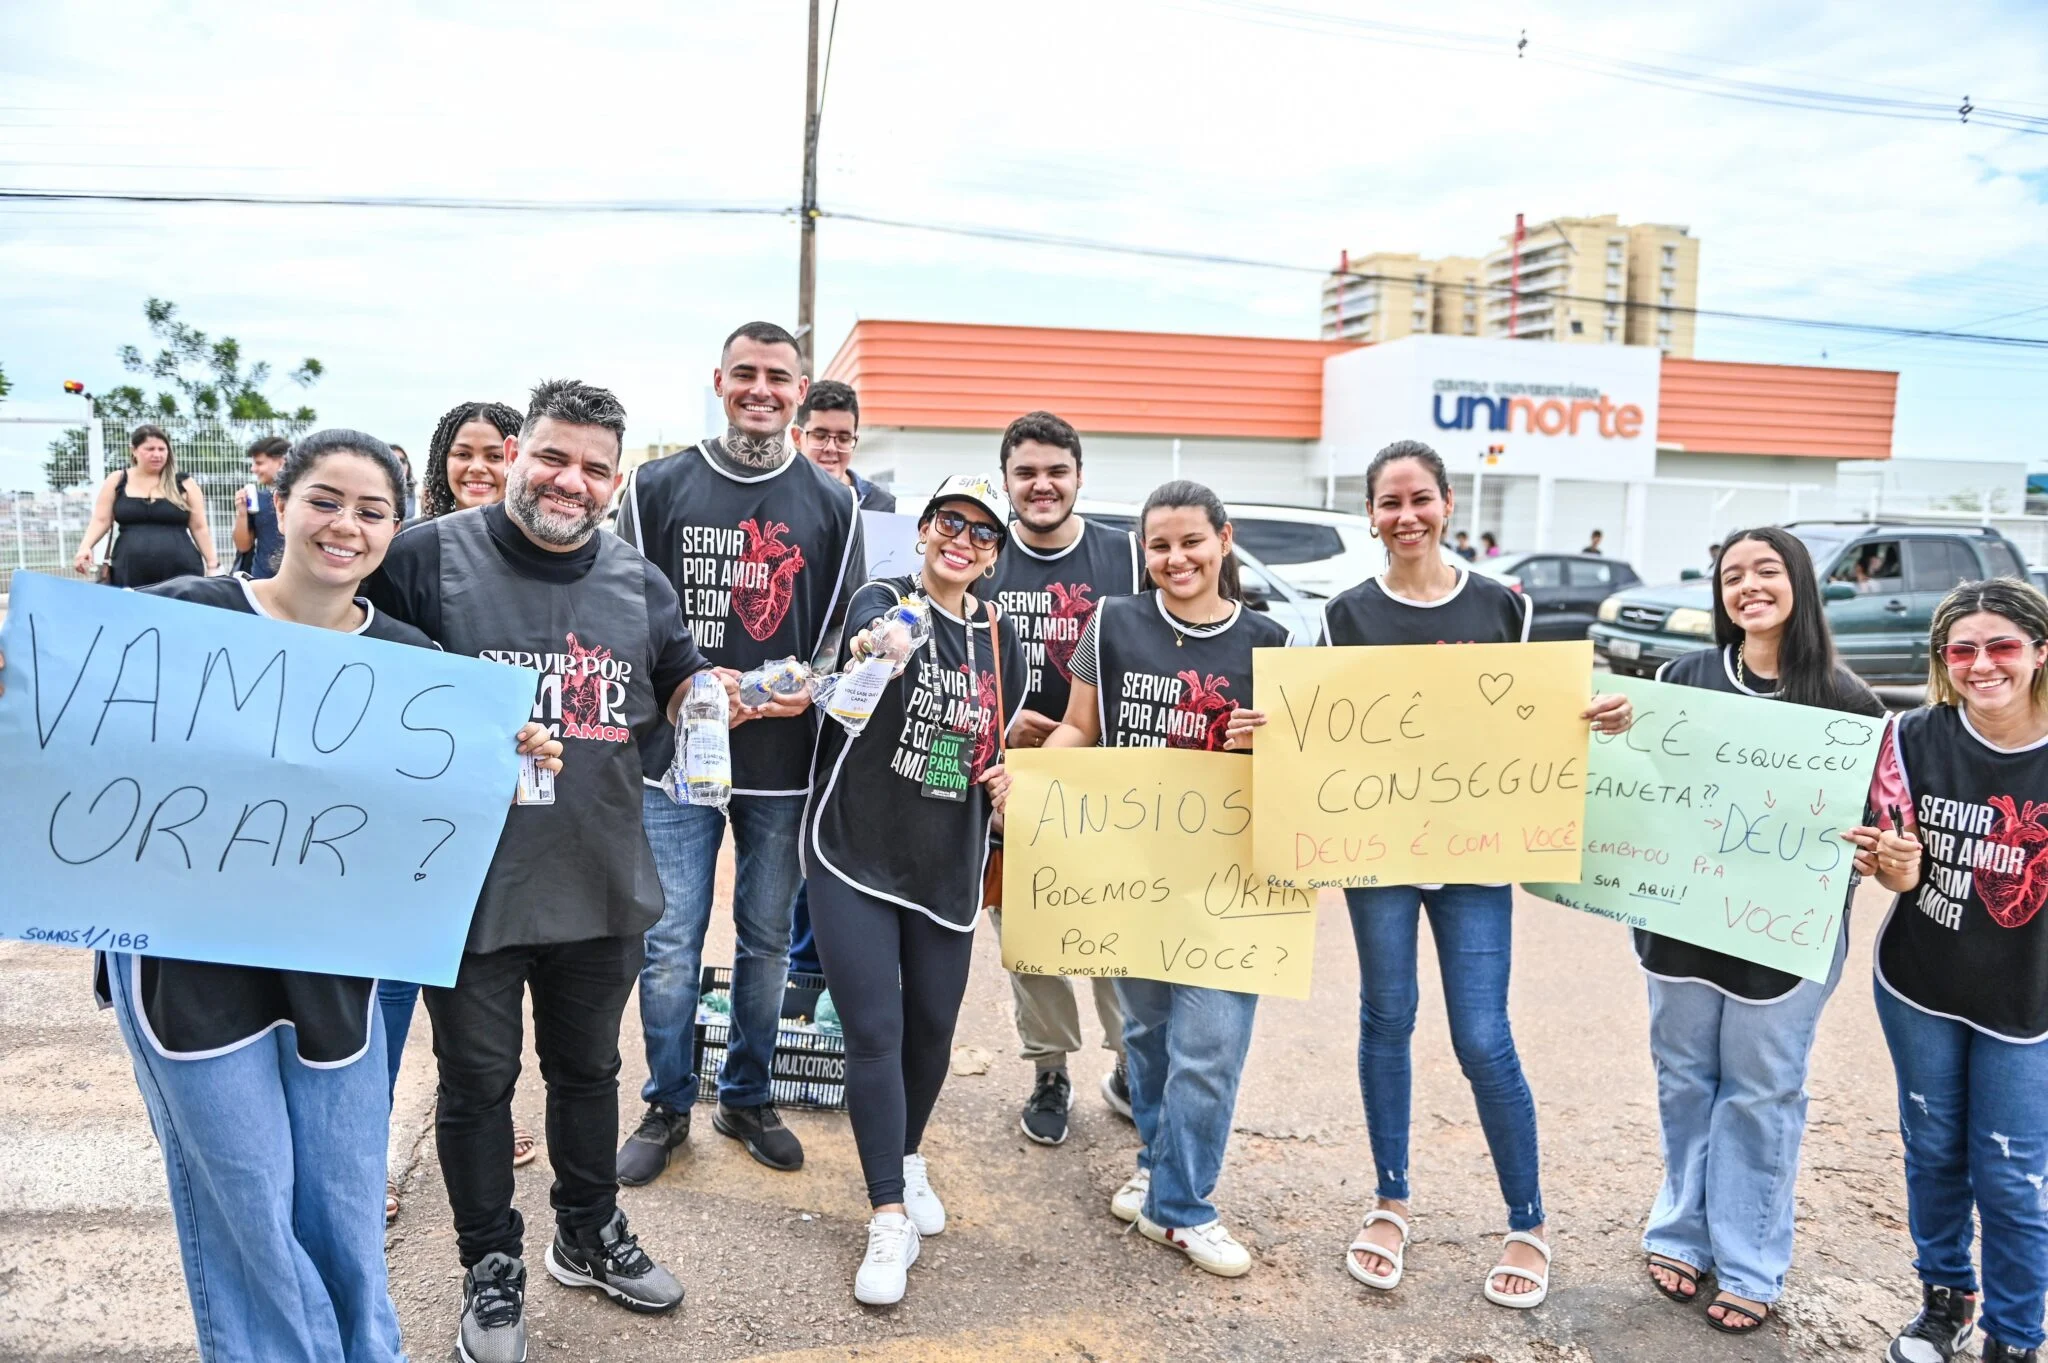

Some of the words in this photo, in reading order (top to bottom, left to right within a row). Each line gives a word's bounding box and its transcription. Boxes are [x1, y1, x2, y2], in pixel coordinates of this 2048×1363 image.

[1433, 393, 1644, 438] uninorte
[682, 526, 745, 556] SERVIR
[682, 557, 717, 586] POR
[720, 561, 769, 590] AMOR
[684, 588, 695, 615] E
[696, 589, 732, 618] COM
[998, 591, 1052, 614] SERVIR
[1032, 616, 1079, 641] AMOR
[583, 656, 633, 684] POR
[29, 613, 457, 781] VAMOS
[1121, 671, 1182, 705] SERVIR
[563, 722, 631, 744] AMOR
[900, 717, 912, 745] E
[1118, 701, 1153, 732] POR
[1155, 706, 1208, 741] AMOR
[1279, 684, 1425, 752] VOCÊ
[930, 739, 959, 758] AQUI
[1716, 741, 1858, 772] ESQUECEU
[928, 756, 959, 773] PARA
[925, 770, 968, 791] SERVIR
[1317, 757, 1579, 813] CONSEGUE
[1918, 794, 1994, 836] SERVIR
[1296, 832, 1387, 871] DEUS
[1410, 820, 1430, 856] É
[1447, 832, 1501, 857] COM
[1522, 820, 1578, 850] VOCÊ
[1719, 803, 1841, 872] DEUS
[1957, 838, 2026, 875] AMOR
[1033, 866, 1170, 910] PODEMOS
[1267, 874, 1296, 888] REDE
[1593, 874, 1621, 888] SUA
[1916, 883, 1963, 931] AMOR
[1061, 928, 1119, 955] POR
[1015, 960, 1045, 974] REDE
[774, 1054, 846, 1079] MULTCITROS
